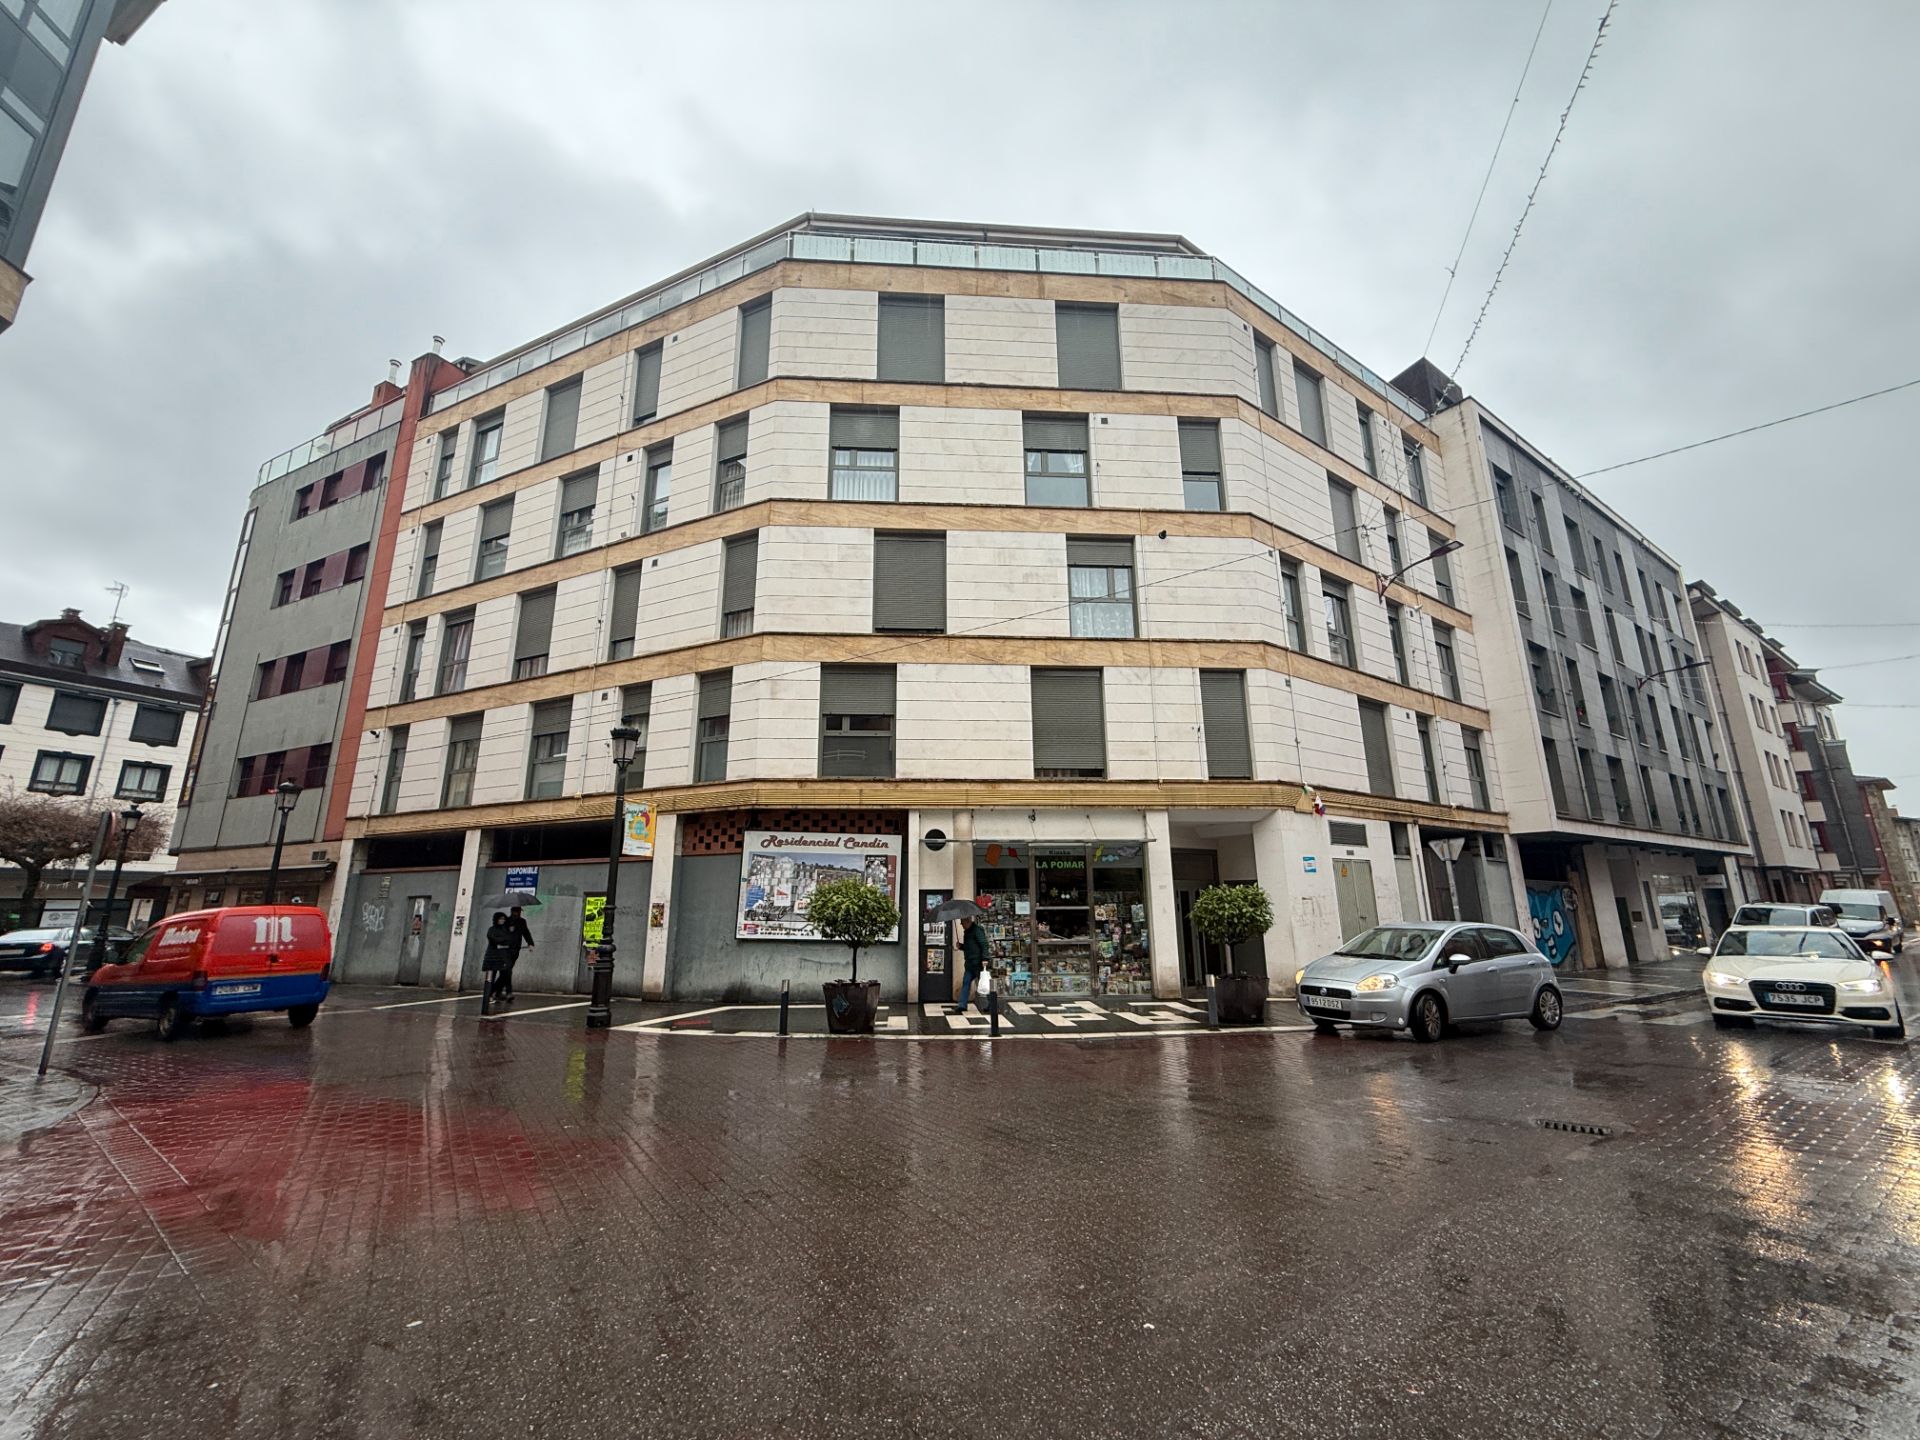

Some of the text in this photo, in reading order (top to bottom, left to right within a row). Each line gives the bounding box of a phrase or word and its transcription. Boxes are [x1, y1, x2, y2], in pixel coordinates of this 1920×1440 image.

[761, 835, 842, 848] Residencial
[1036, 861, 1085, 869] LA POMAR
[1770, 993, 1821, 1004] 7535 JCP
